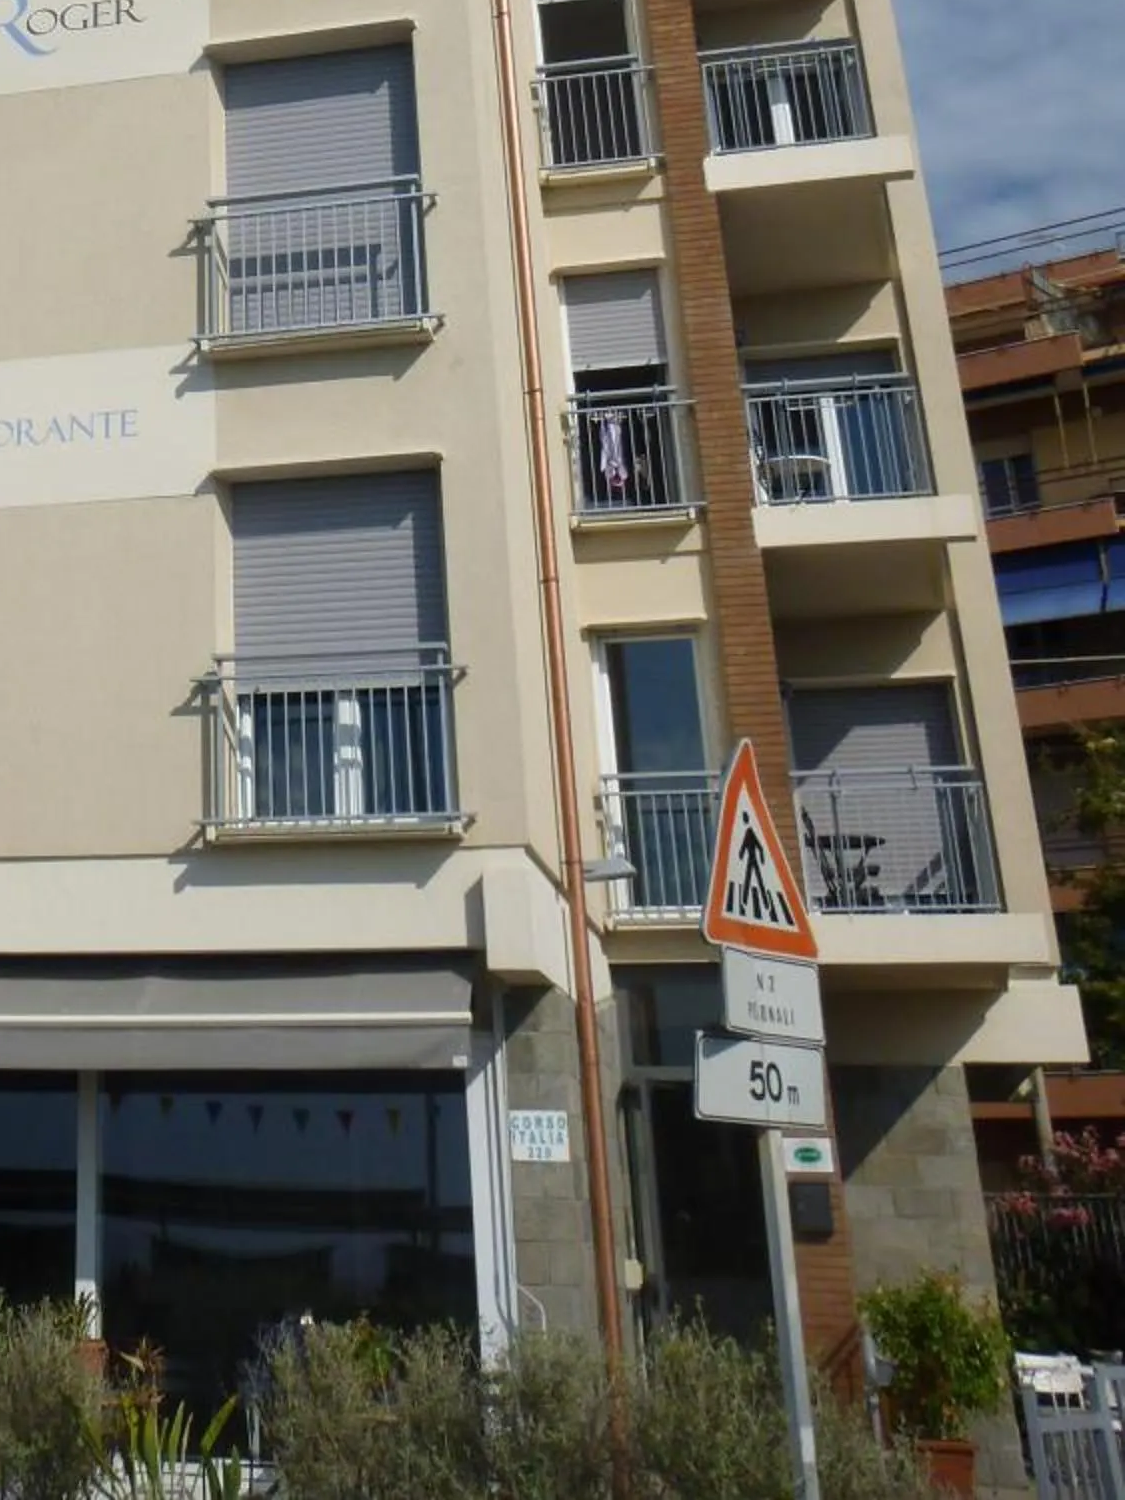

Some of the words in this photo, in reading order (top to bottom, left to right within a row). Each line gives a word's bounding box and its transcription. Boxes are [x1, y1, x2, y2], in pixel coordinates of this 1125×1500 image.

[749, 1060, 783, 1102] 50
[787, 1085, 801, 1105] m
[510, 1115, 566, 1130] CORSO
[512, 1130, 565, 1145] ITALIA
